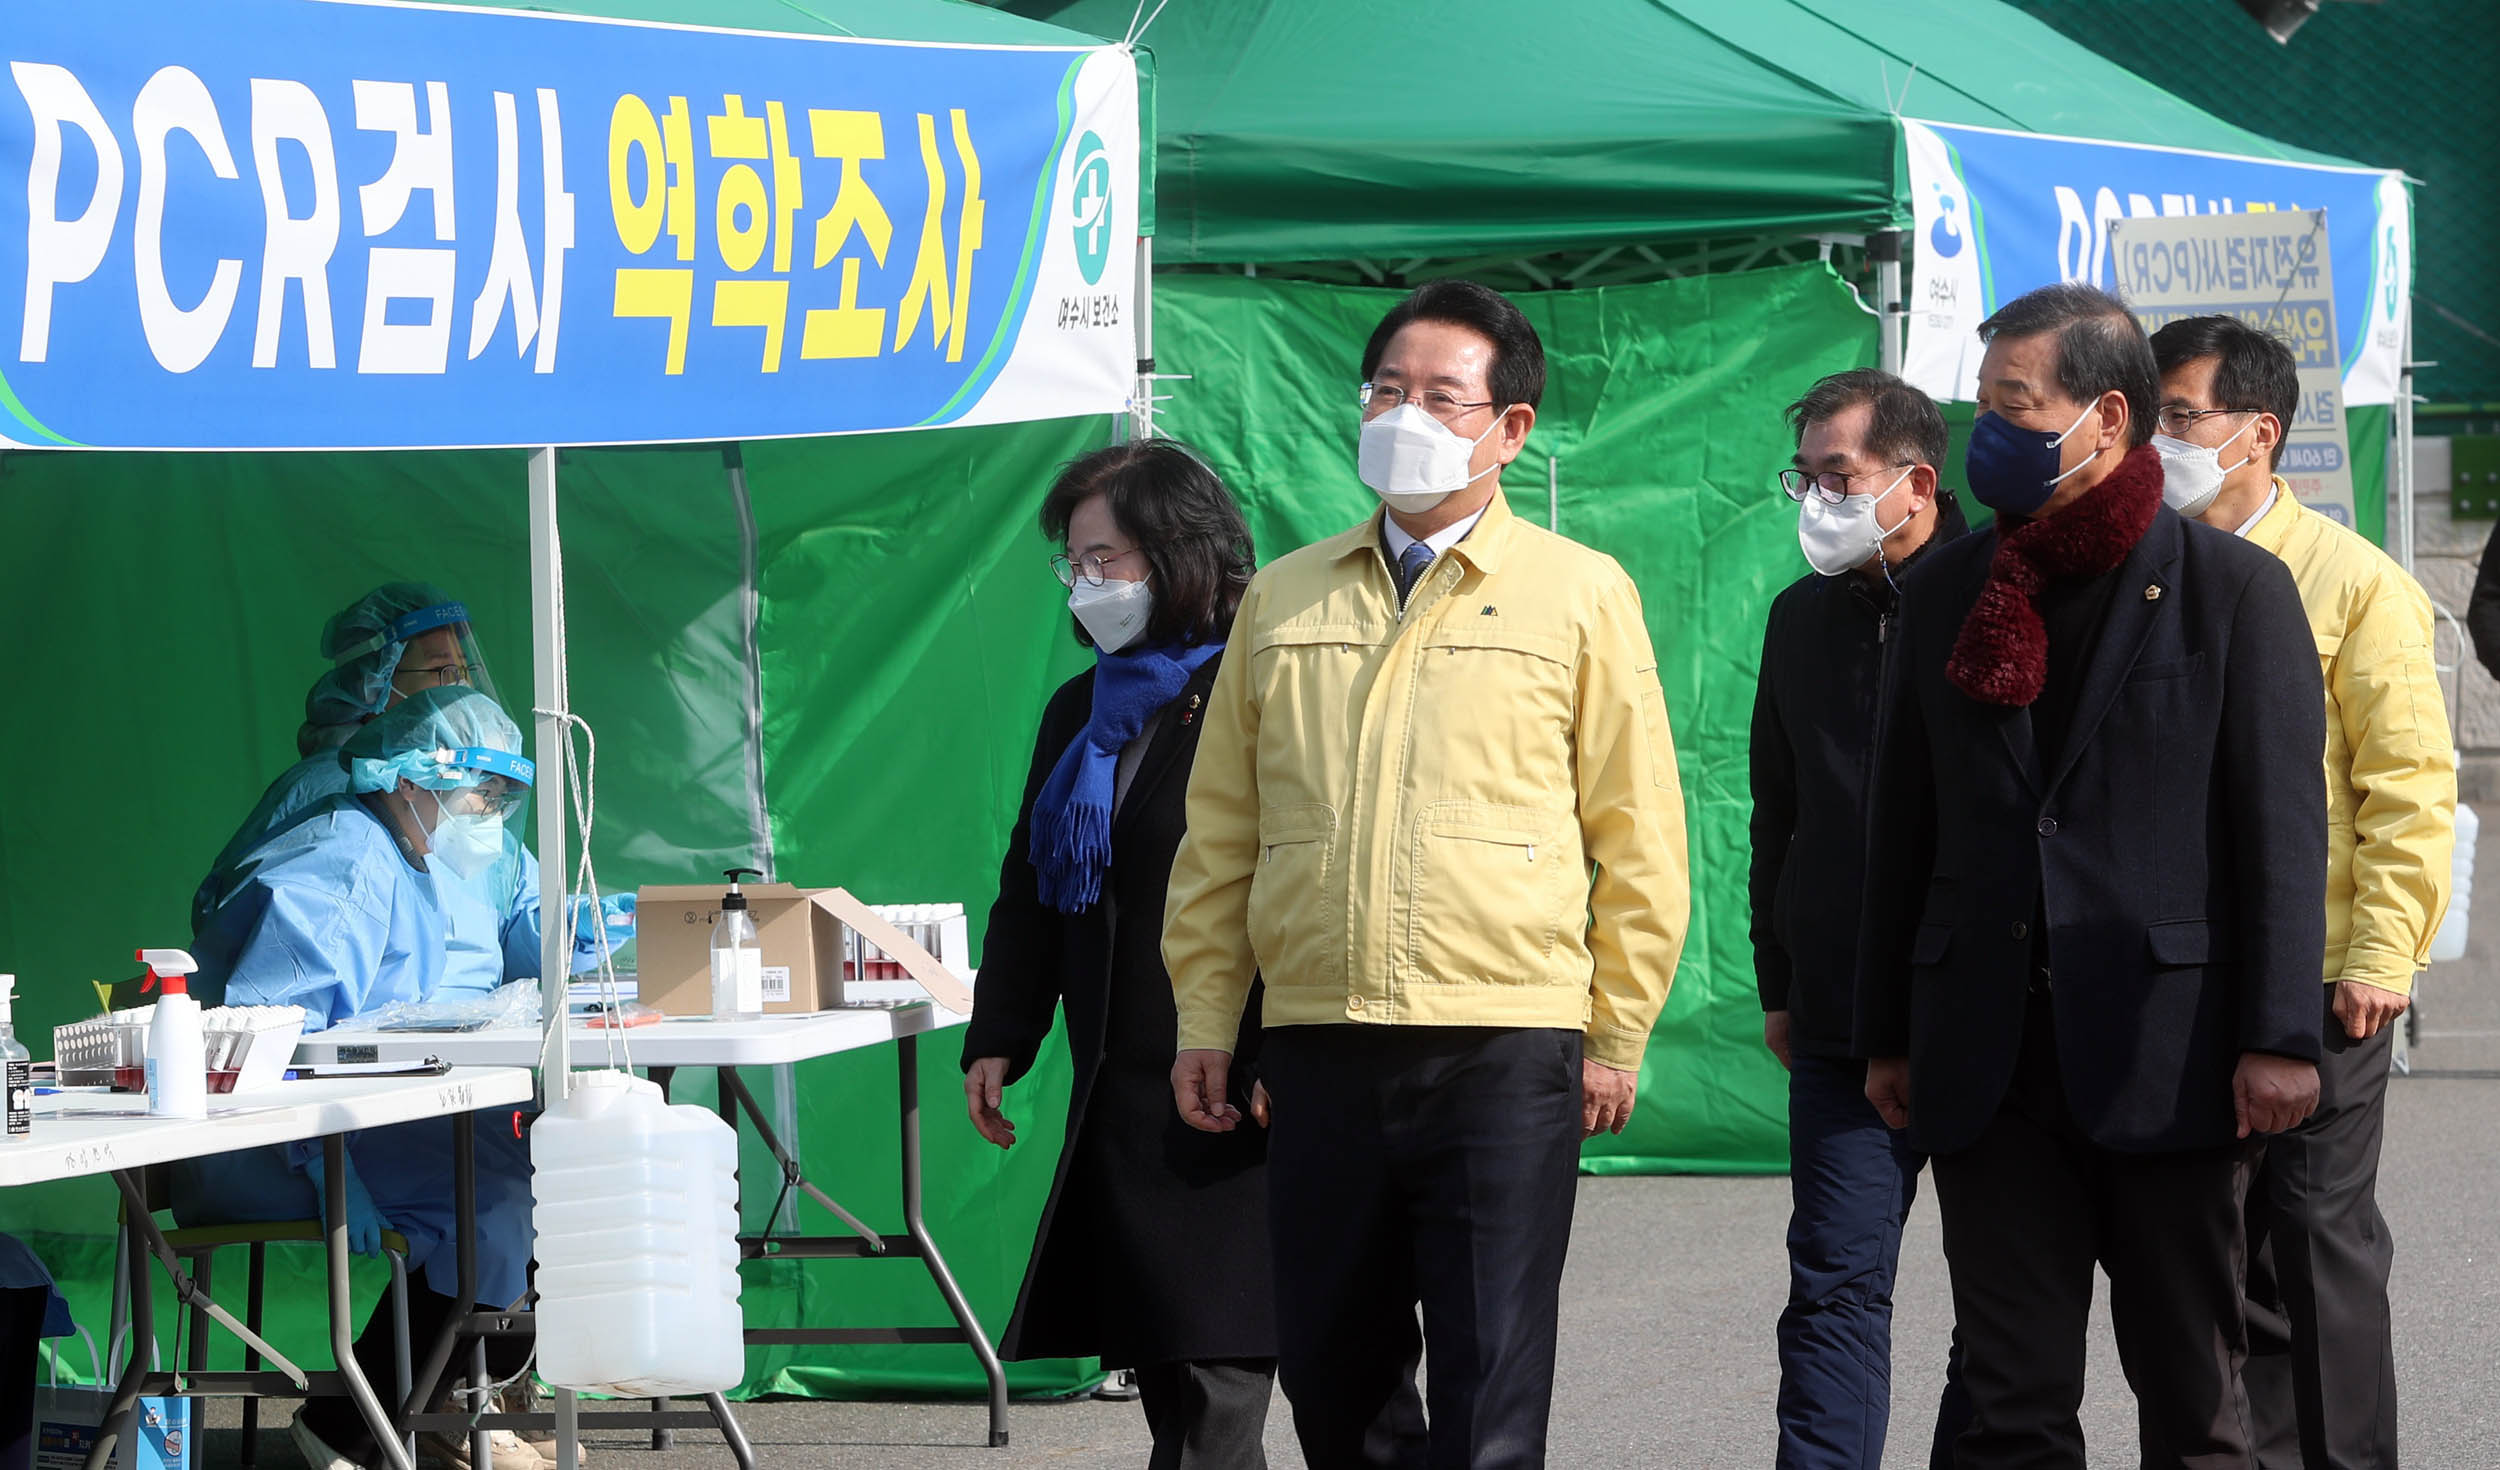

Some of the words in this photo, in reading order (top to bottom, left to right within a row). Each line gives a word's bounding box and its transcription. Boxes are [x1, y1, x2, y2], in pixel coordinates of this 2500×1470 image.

[10, 61, 575, 374] PCR검사
[608, 93, 985, 376] 역학조사
[1058, 296, 1089, 330] 여수시
[1093, 294, 1119, 327] 보건소
